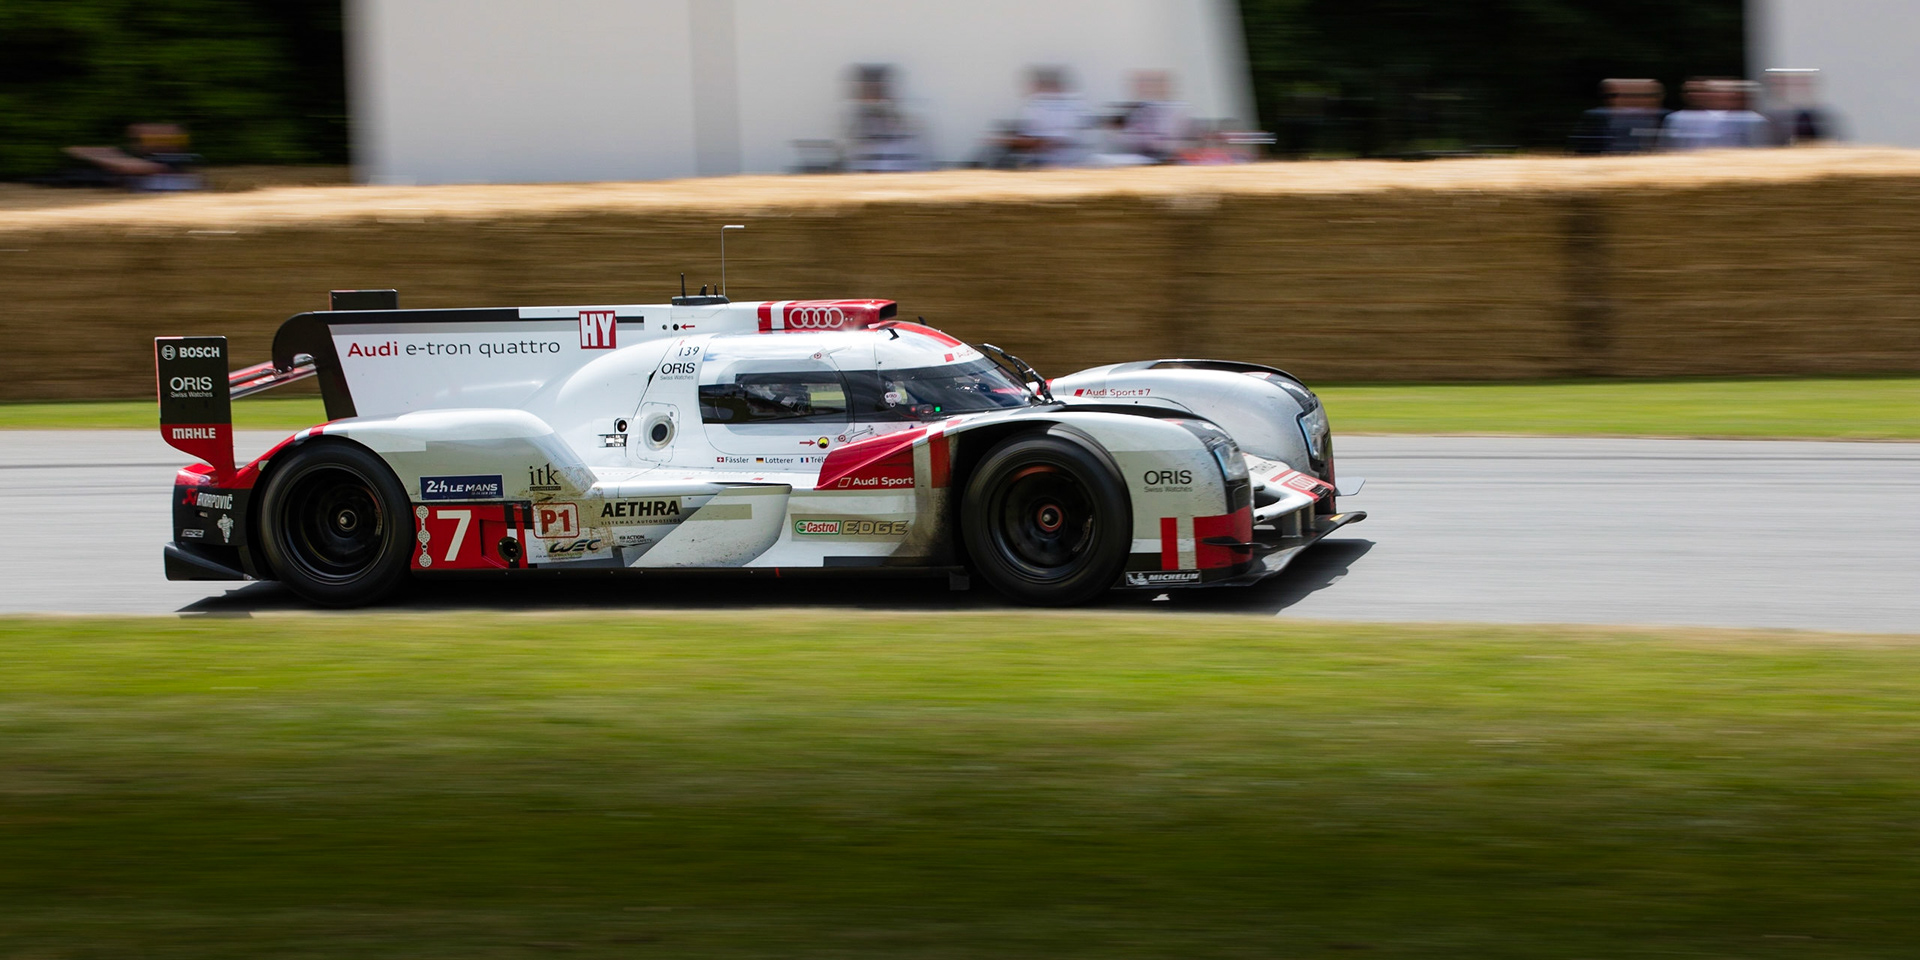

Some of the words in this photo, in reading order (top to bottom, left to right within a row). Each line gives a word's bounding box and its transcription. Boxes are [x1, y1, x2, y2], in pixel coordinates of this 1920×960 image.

[580, 313, 615, 347] HY
[179, 347, 220, 358] BOSCH
[347, 341, 399, 357] Audi
[405, 341, 471, 356] e-tron
[479, 339, 561, 359] quattro
[678, 346, 700, 357] 139
[661, 362, 696, 375] ORIS
[170, 376, 213, 391] ORIS
[1086, 388, 1107, 396] Audi
[1110, 388, 1136, 398] Sport
[172, 428, 216, 439] MAHLE
[725, 456, 749, 464] Fässler
[765, 456, 794, 464] Lotterer
[529, 463, 560, 486] itk
[1144, 470, 1193, 485] ORIS
[426, 480, 448, 493] 24h
[450, 484, 464, 492] LE
[465, 483, 498, 492] MANS
[852, 477, 878, 486] Audi
[881, 476, 914, 487] Sport
[600, 500, 680, 518] AETHRA
[541, 509, 571, 534] P1
[806, 522, 838, 533] Castrol
[841, 520, 909, 535] EDGE
[436, 509, 472, 562] 7
[549, 539, 601, 553] WEC
[1148, 573, 1200, 581] MICHELIN
